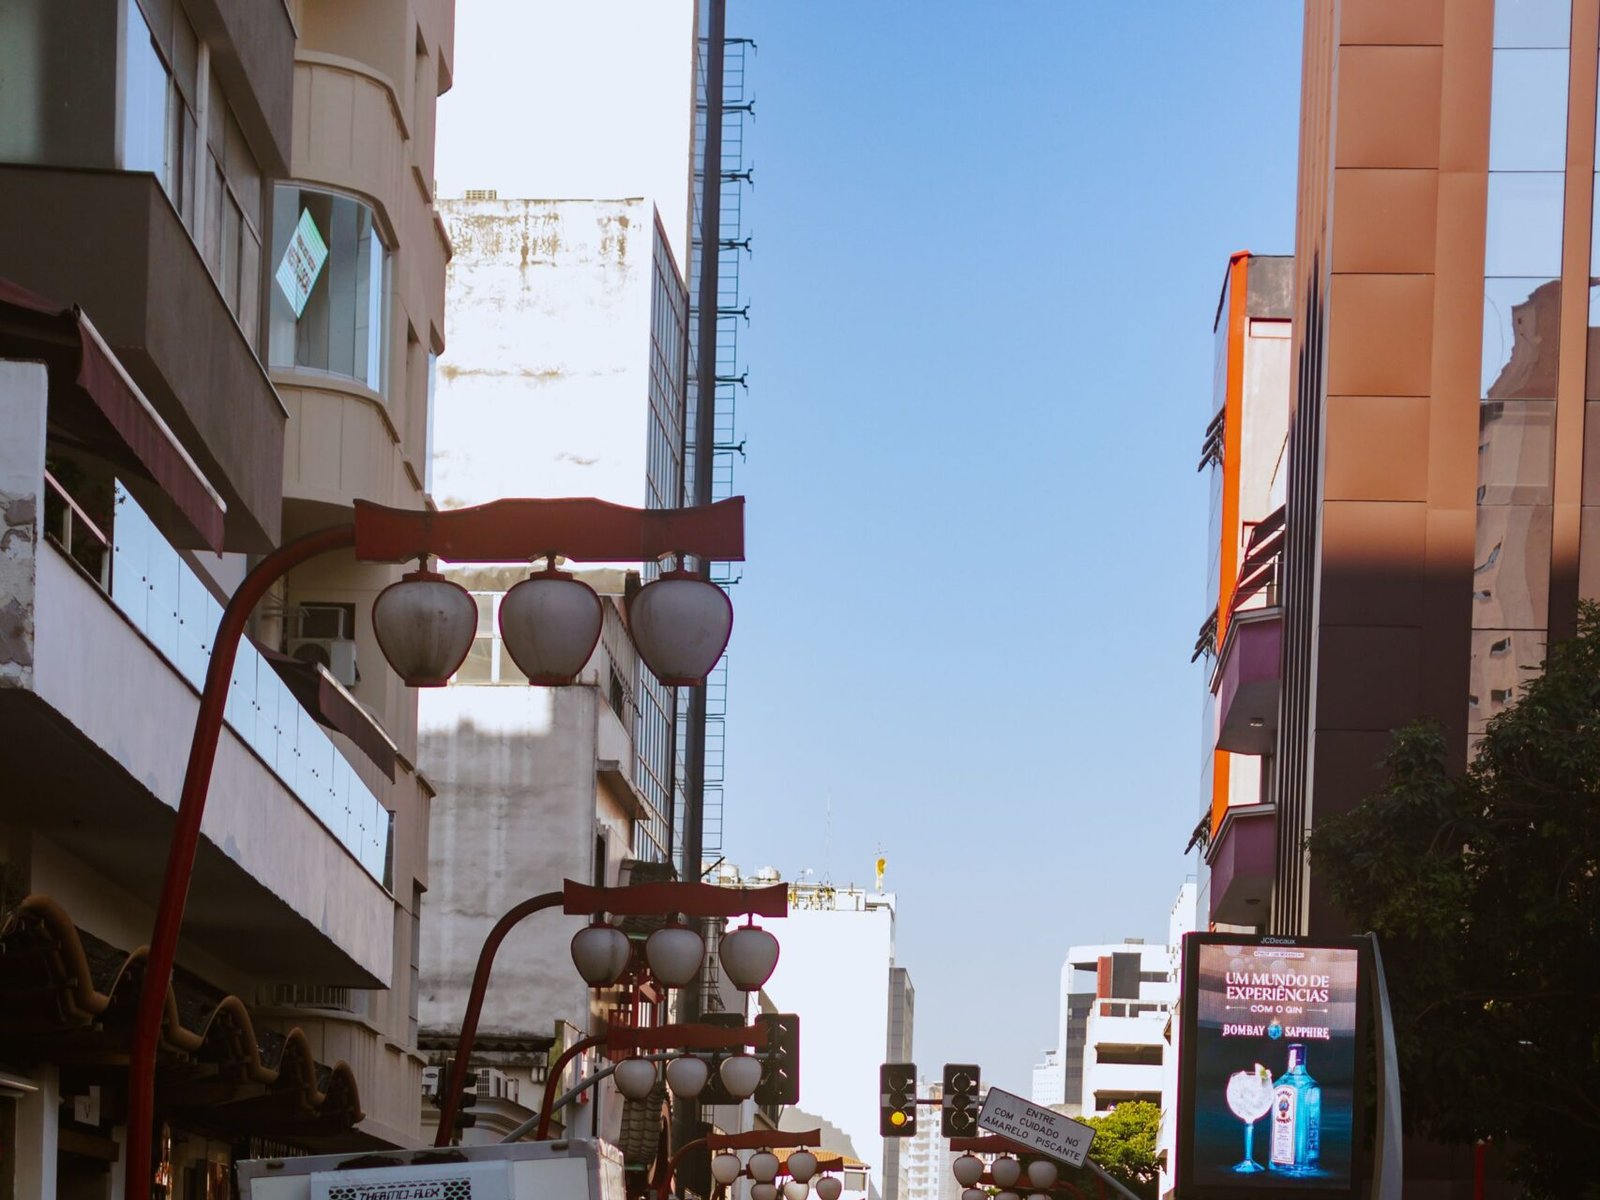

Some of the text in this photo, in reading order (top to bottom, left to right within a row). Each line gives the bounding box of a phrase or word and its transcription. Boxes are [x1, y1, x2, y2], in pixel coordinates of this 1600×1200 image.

[1260, 937, 1296, 945] JCDecaux
[1225, 971, 1330, 988] UM MUNDO DE
[1226, 985, 1329, 1003] EXPERIÊNCIAS
[1250, 1004, 1303, 1014] COM O GIN
[1222, 1023, 1330, 1040] BOMBAY SAPPHIRE
[1025, 1107, 1056, 1126] ENTRE
[994, 1107, 1080, 1148] COM CUIDADO NO
[983, 1116, 1081, 1161] AMARELO PISCANTE
